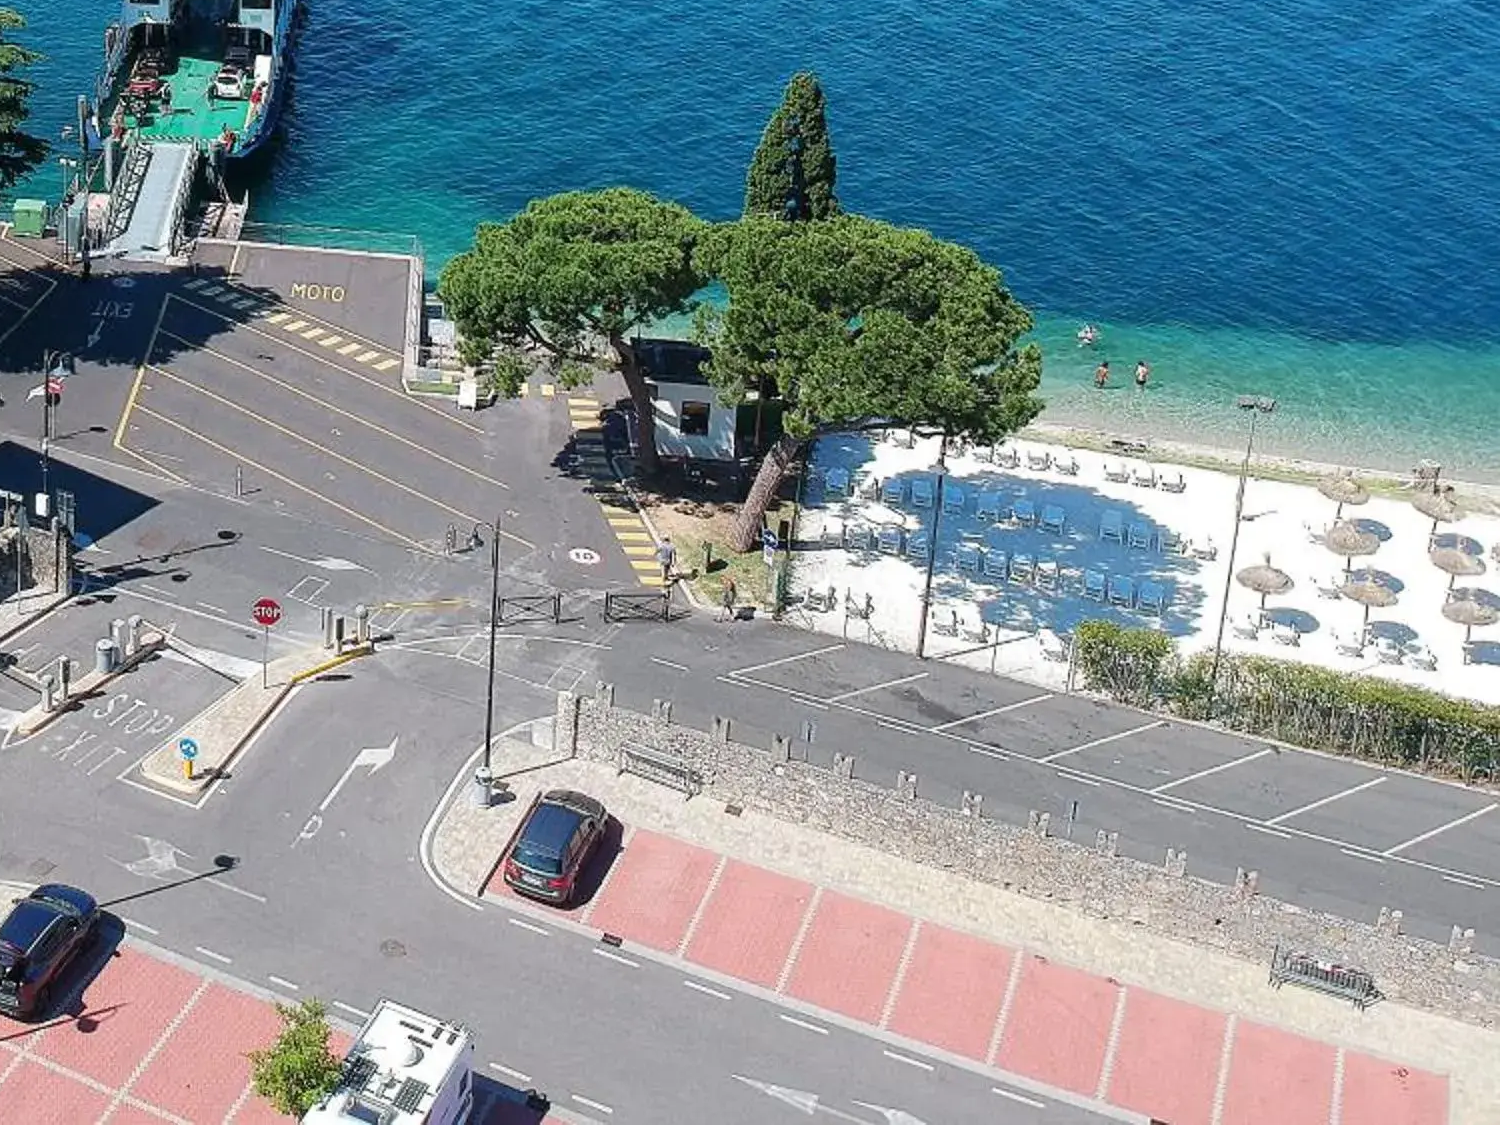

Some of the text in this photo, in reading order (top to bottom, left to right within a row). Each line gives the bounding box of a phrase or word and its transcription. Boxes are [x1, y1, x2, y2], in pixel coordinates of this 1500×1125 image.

[291, 282, 345, 302] MOTO
[252, 606, 282, 618] STOP
[93, 693, 175, 742] STOP
[49, 730, 127, 776] XIT
